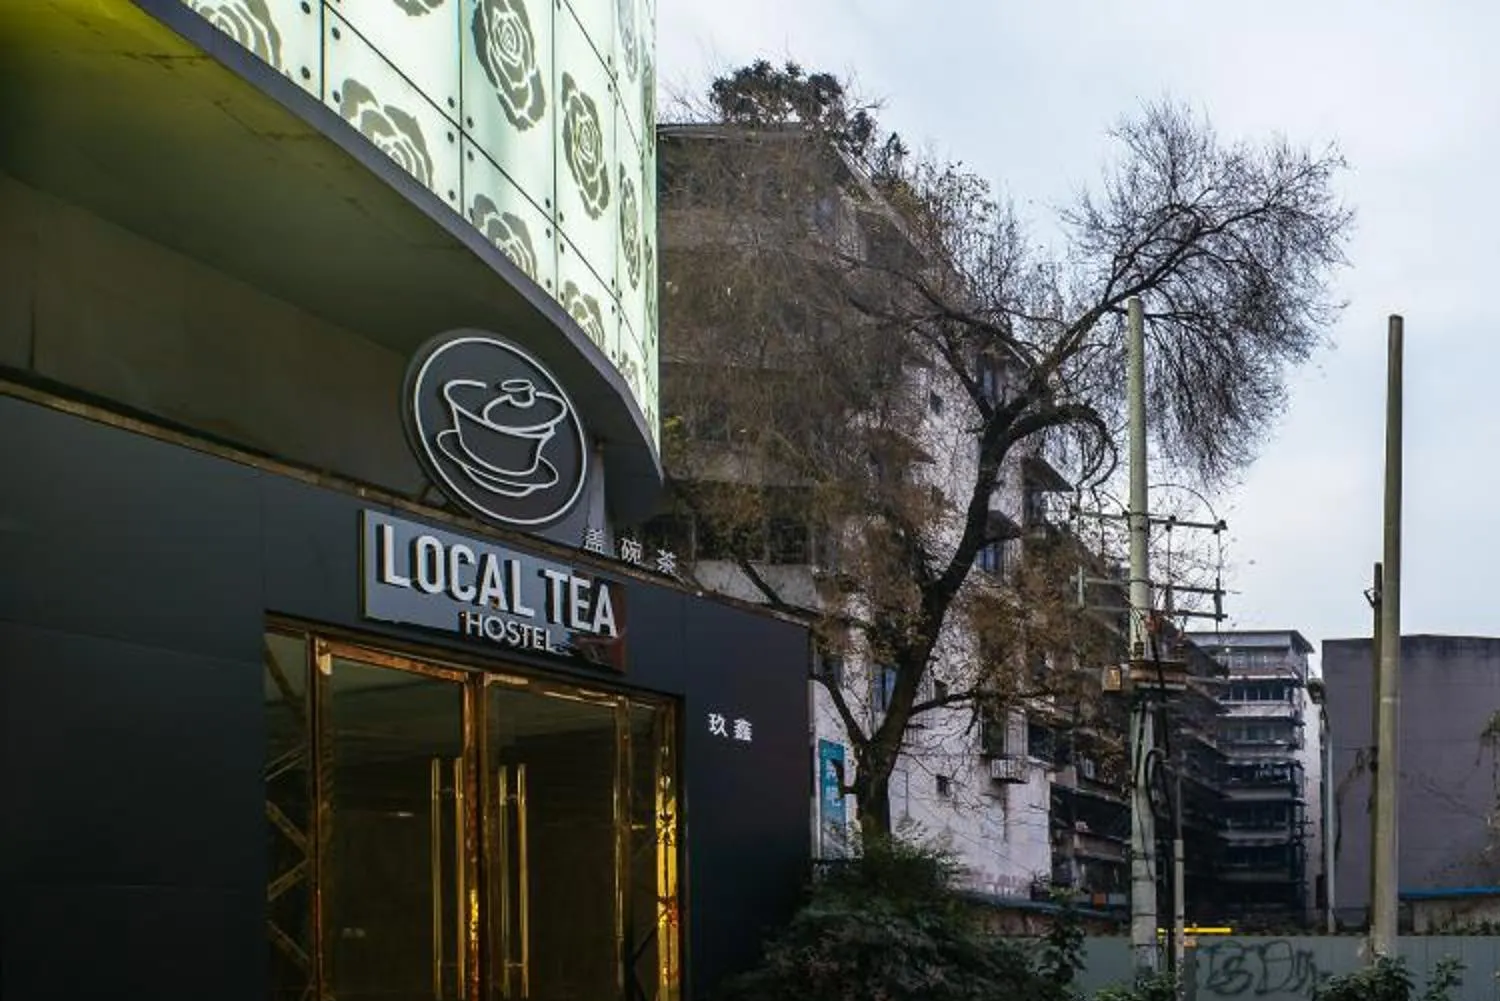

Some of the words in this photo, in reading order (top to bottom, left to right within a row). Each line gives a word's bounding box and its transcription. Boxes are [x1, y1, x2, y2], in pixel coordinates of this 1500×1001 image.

[382, 523, 535, 618] LOCAL
[544, 568, 619, 638] TEA
[464, 610, 563, 652] HOSTEL
